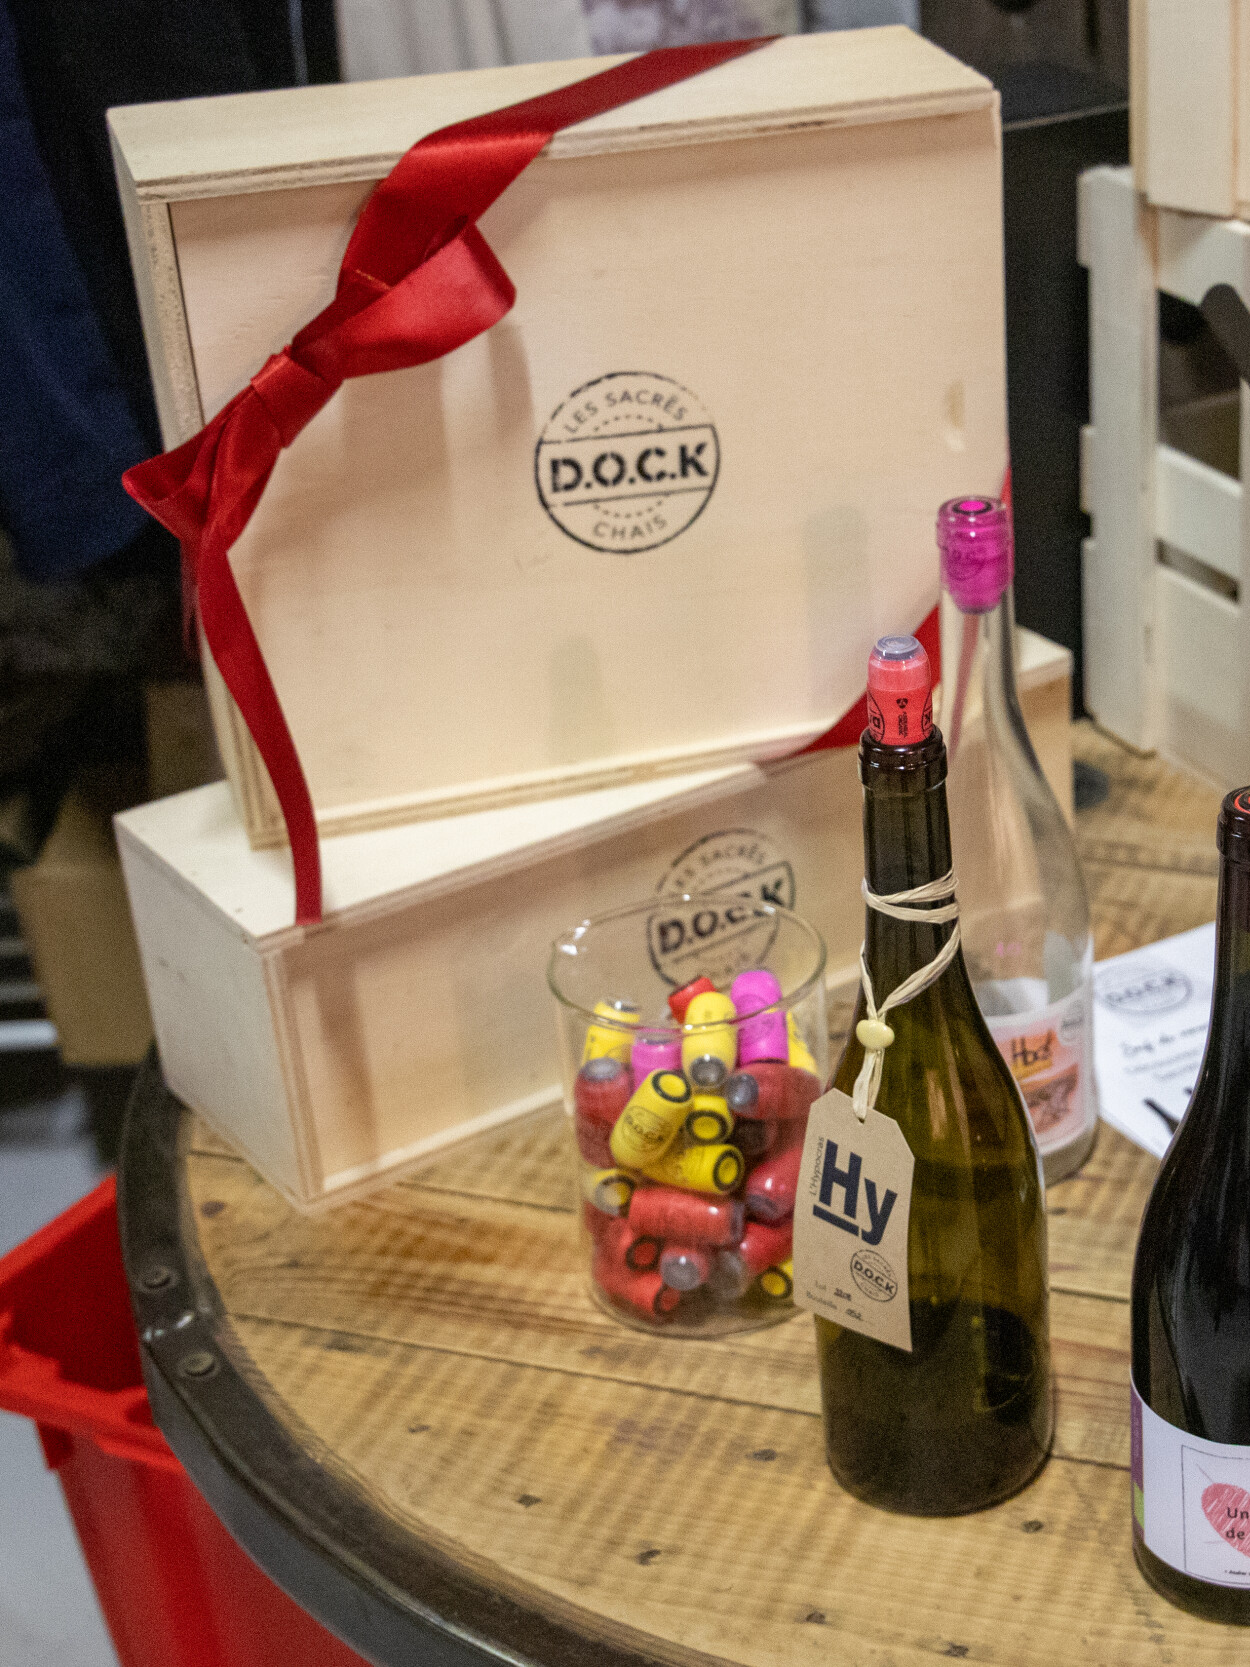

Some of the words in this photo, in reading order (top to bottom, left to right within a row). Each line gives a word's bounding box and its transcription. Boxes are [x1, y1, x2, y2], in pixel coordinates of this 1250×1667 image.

[564, 403, 599, 434] LES
[549, 441, 709, 493] D.O.C.K
[592, 513, 668, 541] CHAIS
[818, 1138, 898, 1246] Hy
[853, 1259, 895, 1295] D.O.C.K
[1227, 1507, 1249, 1520] Un
[1225, 1527, 1246, 1540] de
